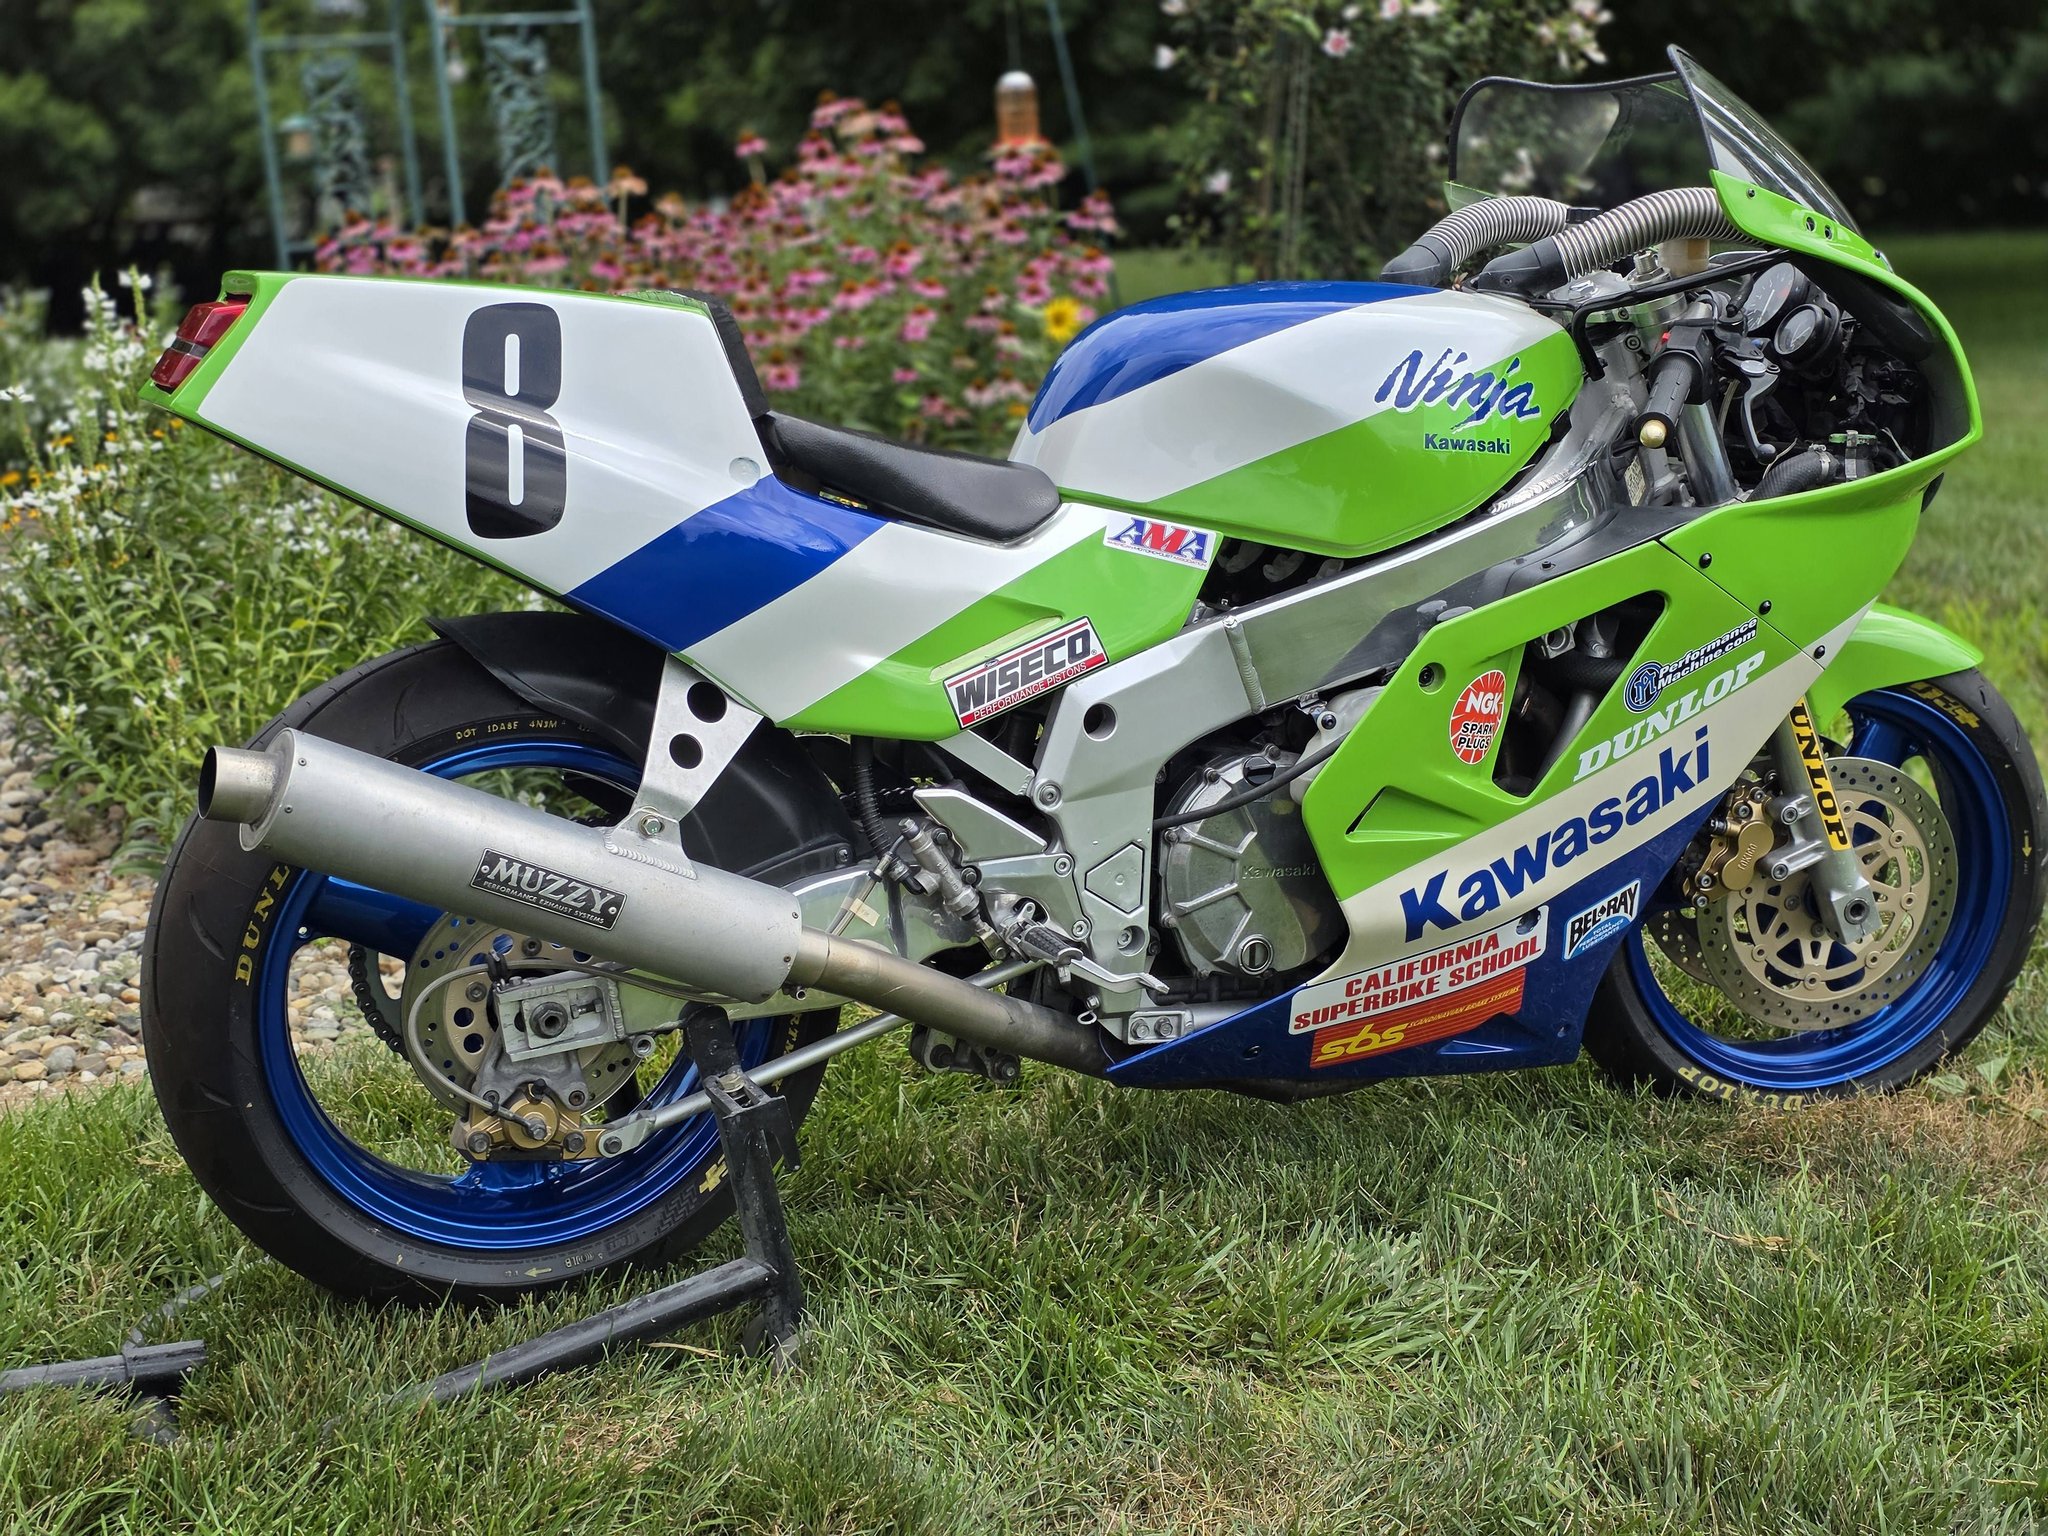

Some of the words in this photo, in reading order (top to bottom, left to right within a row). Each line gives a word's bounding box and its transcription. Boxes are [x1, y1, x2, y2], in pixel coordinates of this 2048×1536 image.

[1374, 347, 1541, 431] Ninja
[462, 302, 566, 539] 8
[1424, 433, 1511, 455] Kawasaki
[1107, 517, 1208, 563] AMA
[955, 628, 1091, 716] WISECO
[1657, 629, 1756, 690] Machine.com
[1658, 617, 1757, 679] Performance
[973, 681, 1045, 720] PERFORMANCE
[1047, 661, 1087, 688] PISTONS
[1465, 690, 1502, 715] NGK
[1573, 650, 1766, 782] DUNLOP
[455, 728, 477, 740] DOT
[1457, 736, 1490, 749] PLUGS
[1461, 722, 1495, 735] SPARK
[1399, 725, 1710, 944] Kawasaki
[487, 857, 615, 914] MUZZY
[1241, 862, 1317, 879] Kawasaki
[483, 880, 537, 903] PERFORMANCE
[539, 898, 573, 913] EXHAUST
[573, 909, 604, 924] SYSTEMS
[1293, 974, 1441, 1030] SUPERBIKE
[1448, 935, 1542, 988] SCHOOL
[1345, 932, 1499, 998] CALIFORNIA
[1314, 1023, 1410, 1062] sbs
